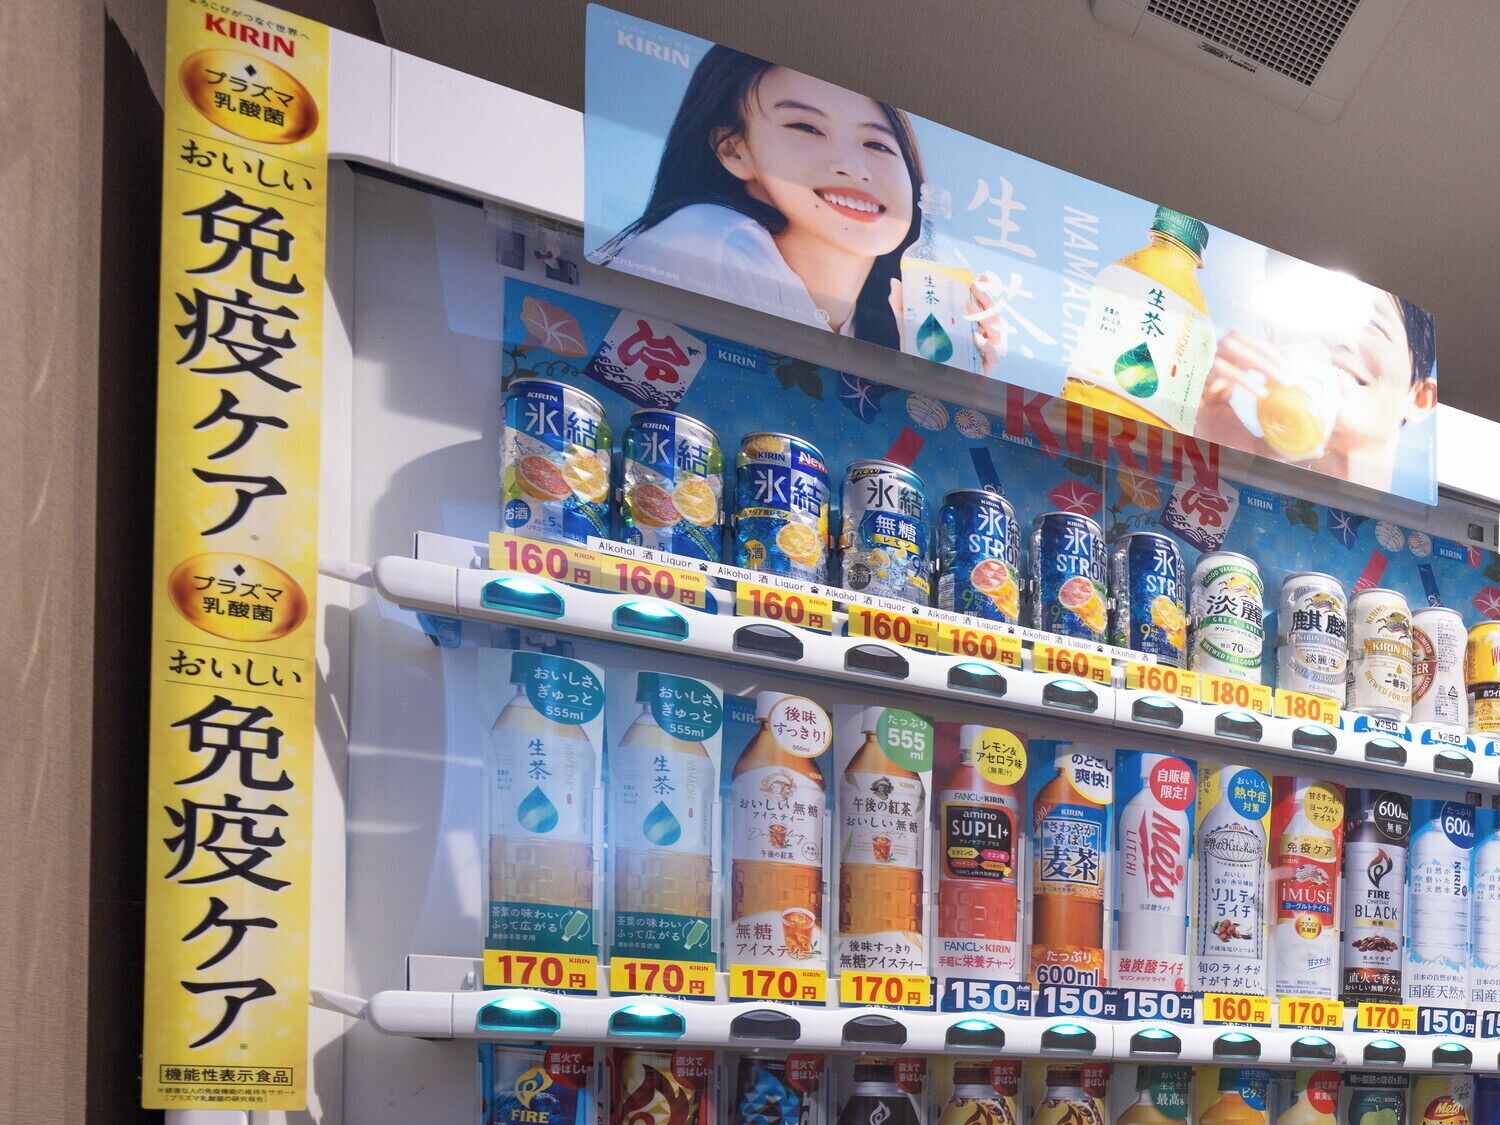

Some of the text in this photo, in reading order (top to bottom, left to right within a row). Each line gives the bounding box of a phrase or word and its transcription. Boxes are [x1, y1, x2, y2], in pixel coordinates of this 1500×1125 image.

[204, 12, 295, 58] KIRIN
[616, 30, 690, 70] KIRIN
[205, 68, 295, 108] プラズマ
[213, 90, 286, 127] 乳酸菌
[180, 139, 313, 191] おいしい
[174, 189, 305, 537] 免疫ケア
[717, 349, 758, 369] KIRIN
[524, 401, 598, 454] 氷結
[1004, 382, 1220, 492] KIRIN
[640, 433, 708, 479] 氷結
[754, 469, 821, 517] 氷結
[867, 478, 923, 521] 氷結
[875, 515, 917, 543] 無糖
[193, 575, 284, 603] プラズマ
[598, 541, 636, 557] Alkohol
[642, 550, 654, 560] 酒
[660, 553, 692, 570] Liquor
[717, 567, 752, 581] Alkohol
[758, 574, 769, 584] 酒
[774, 577, 804, 592] Liquor
[825, 588, 857, 602] Alkohol
[863, 595, 873, 605] 酒
[878, 599, 905, 613] Liquor
[928, 610, 957, 623] Alkohol
[976, 618, 1002, 634] Liquor
[1022, 629, 1050, 641] Alkohol
[1068, 637, 1092, 650] Liquor
[1110, 647, 1137, 659] Alkohol
[202, 595, 274, 623] 乳酸菌
[1206, 594, 1264, 628] 淡麗
[168, 647, 302, 687] おいしい
[545, 705, 585, 721] 555ml
[785, 706, 817, 725] 後味
[887, 713, 928, 730] たっぷり
[1374, 719, 1398, 732] ¥250
[670, 723, 704, 738] 555ml
[887, 731, 926, 751] 555
[1437, 731, 1461, 744] ¥250
[1157, 768, 1190, 785] 自販機
[852, 796, 913, 818] 午後の紅茶
[1234, 786, 1271, 804] 熱中症
[962, 809, 997, 821] amino
[1043, 848, 1098, 881] 麦茶
[1150, 809, 1185, 901] Mets
[162, 694, 294, 1051] 免疫ケア
[1367, 889, 1391, 900] FIRE
[1353, 903, 1399, 921] BLACK
[735, 922, 773, 941] 無糖
[1046, 949, 1093, 964] たっぷり
[497, 954, 587, 989] 170円
[623, 962, 705, 995] 170円
[741, 969, 817, 1001] 170円
[1037, 965, 1099, 987] 600ml
[851, 976, 921, 1005] 170円
[951, 981, 1030, 1012] 150円
[1043, 987, 1116, 1016] 150円
[1408, 984, 1466, 1000] 国産天然水
[1123, 991, 1193, 1020] 150円
[1212, 996, 1265, 1023] 160円
[1287, 1001, 1337, 1027] 170円
[1364, 1006, 1411, 1030] 170円
[1420, 1010, 1475, 1034] 150円
[164, 1067, 290, 1085] 機能性表示食品
[511, 1109, 550, 1124] FIRE
[1434, 1101, 1462, 1116] Mets
